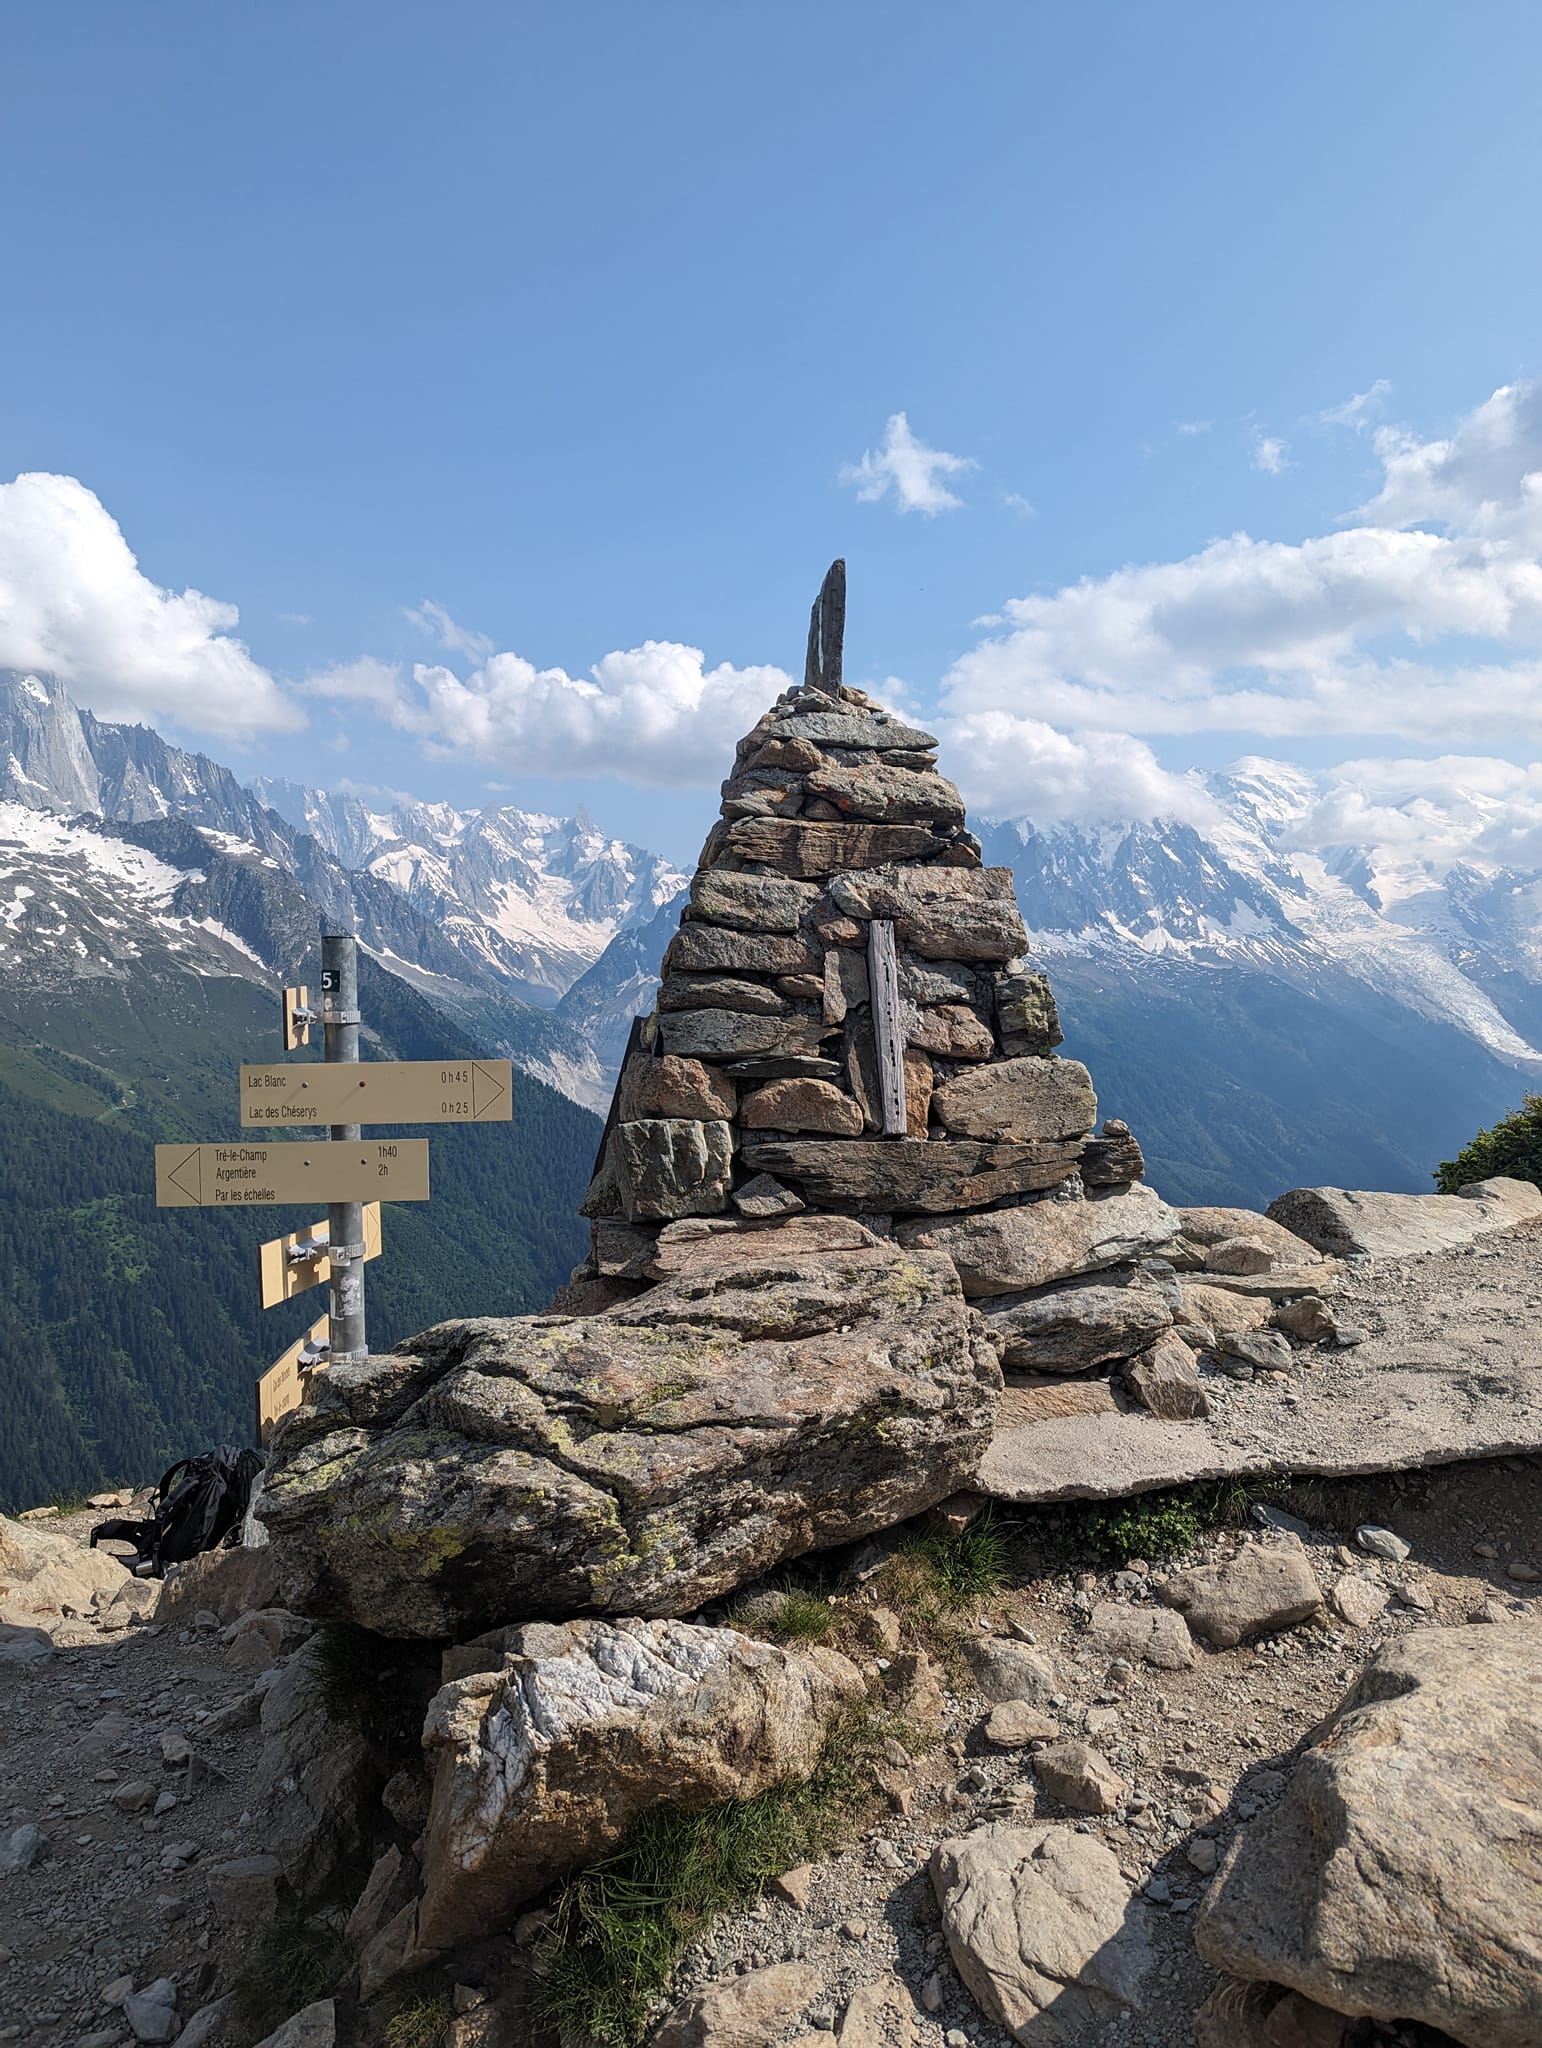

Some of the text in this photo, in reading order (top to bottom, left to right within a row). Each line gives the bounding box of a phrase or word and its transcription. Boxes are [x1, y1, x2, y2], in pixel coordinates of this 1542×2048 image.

[322, 972, 333, 989] 5
[248, 1074, 287, 1088] Lac Blanc
[249, 1104, 318, 1120] Lac des Chéserys
[214, 1149, 267, 1164] Tré-le-Champ
[378, 1145, 397, 1158] 1h40
[216, 1166, 257, 1182] Argentière
[378, 1163, 389, 1176] 2h
[215, 1188, 275, 1201] Par les échelles
